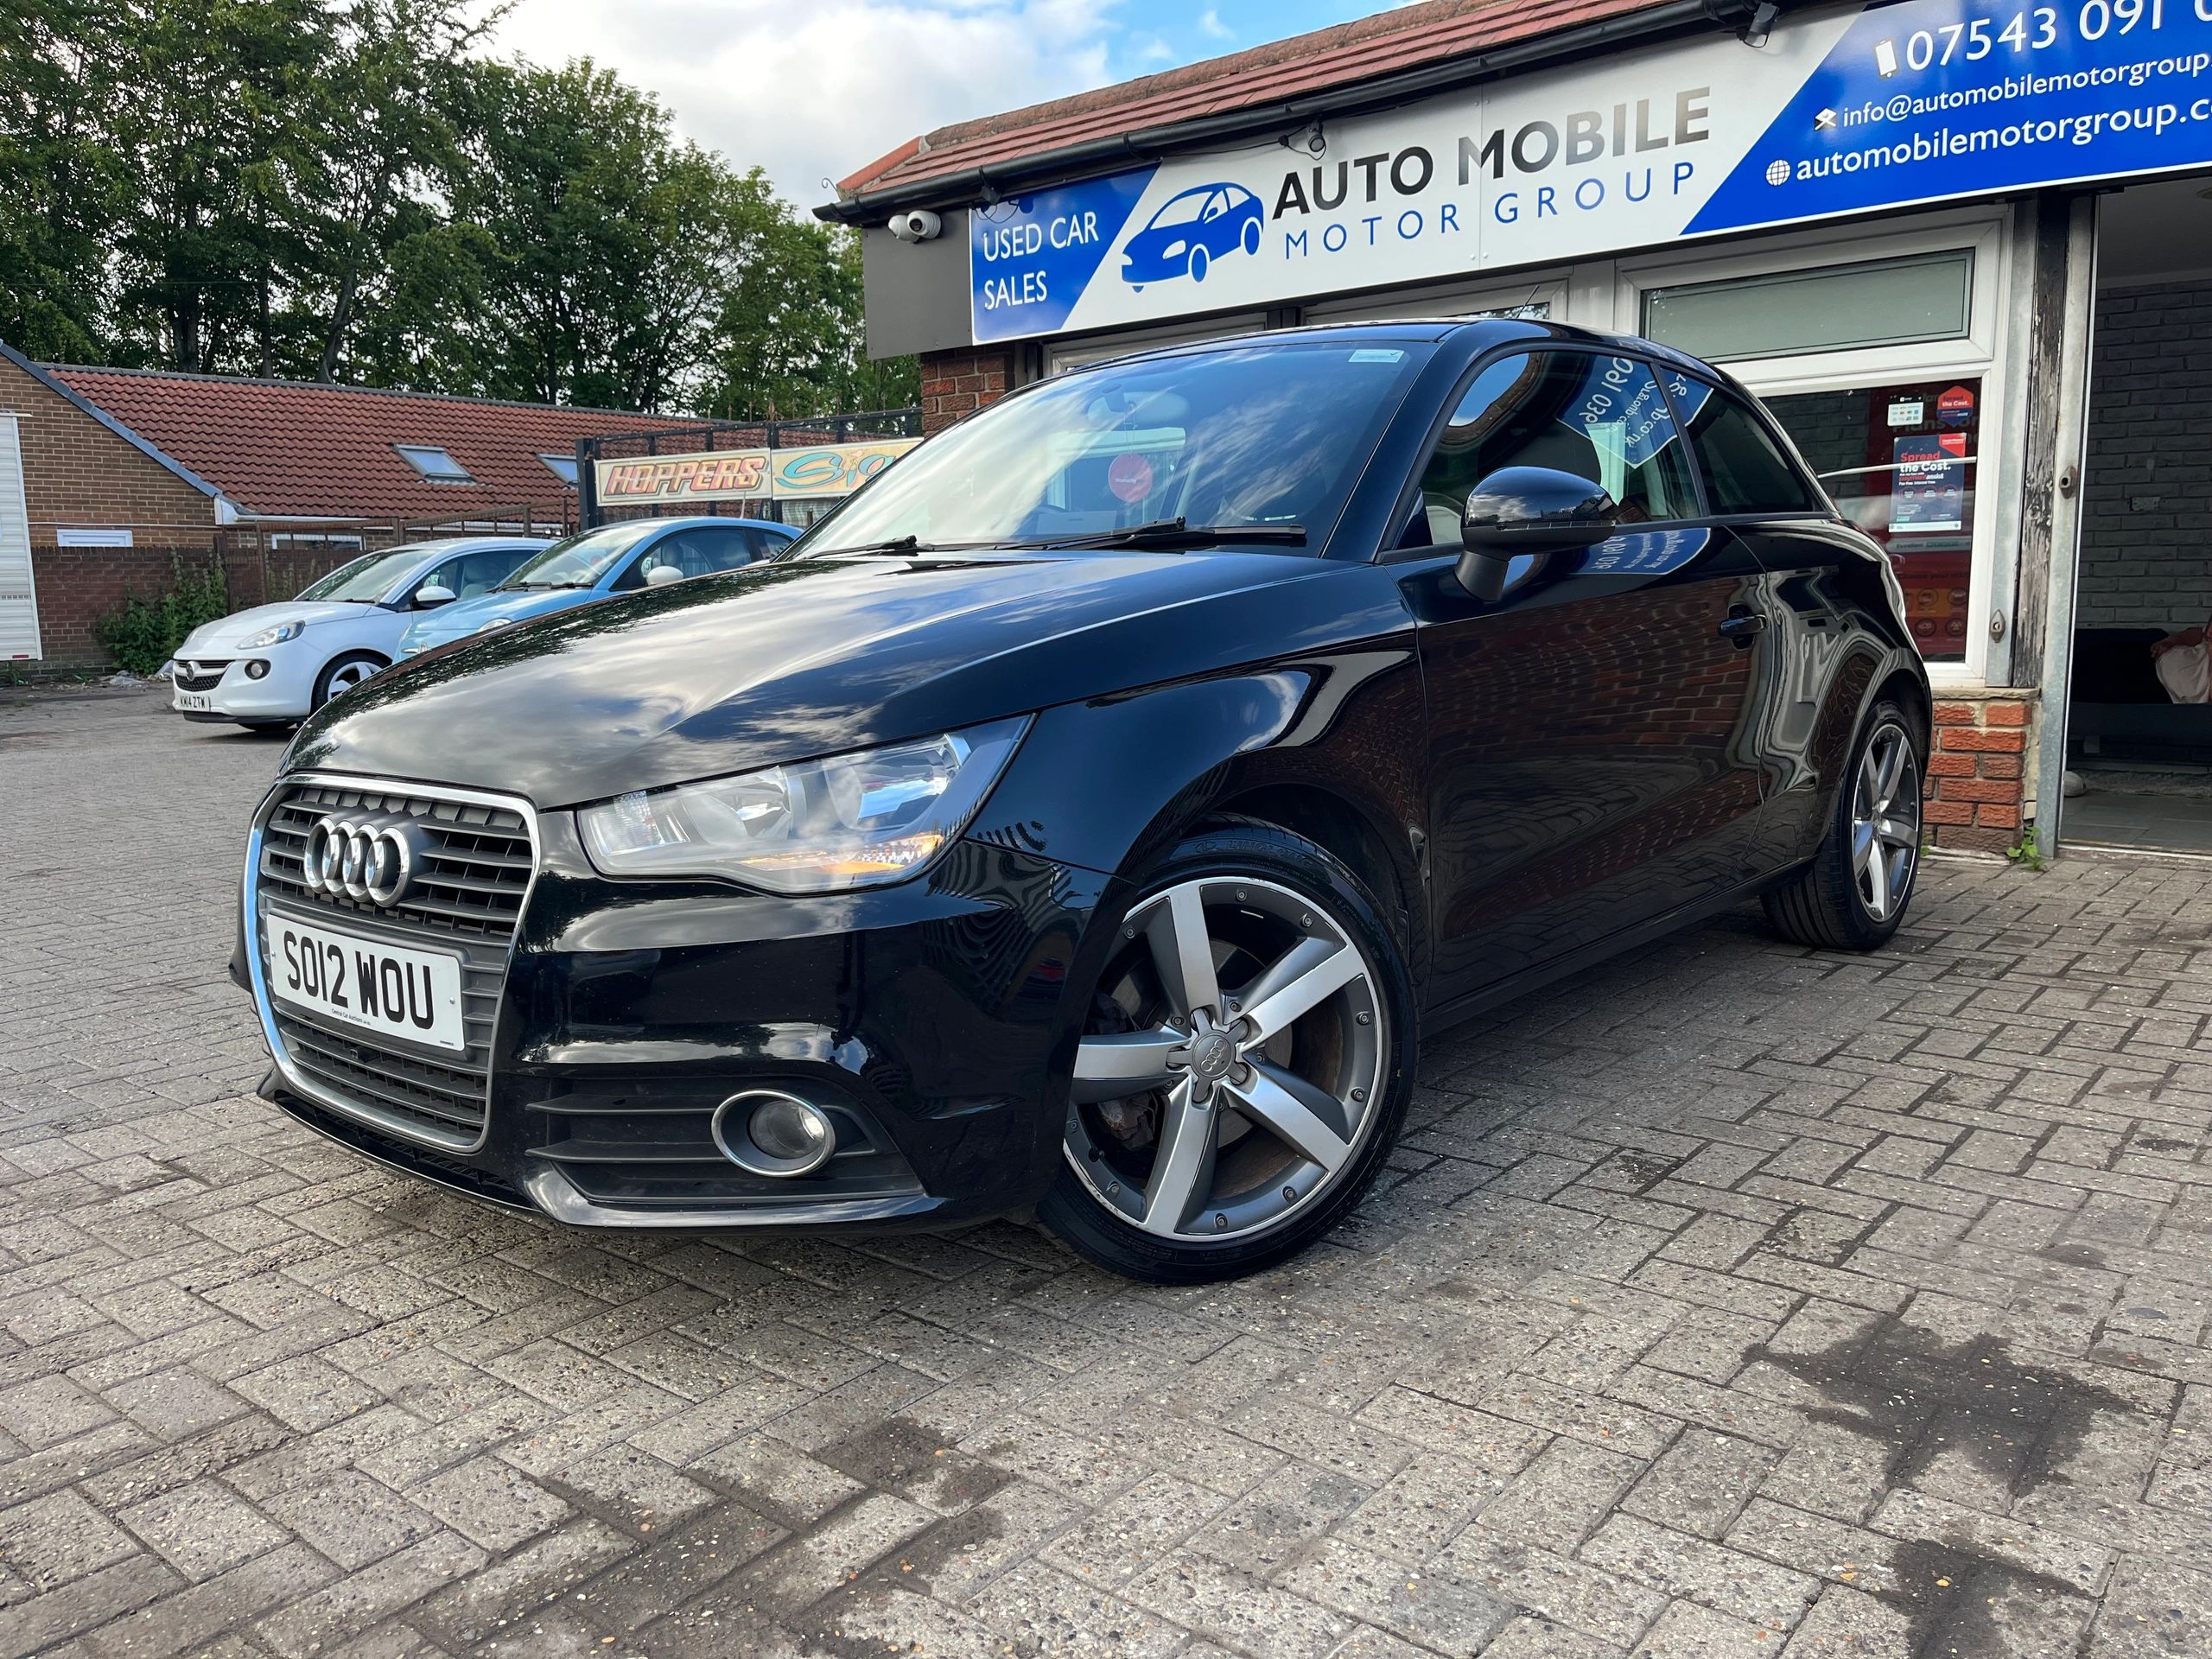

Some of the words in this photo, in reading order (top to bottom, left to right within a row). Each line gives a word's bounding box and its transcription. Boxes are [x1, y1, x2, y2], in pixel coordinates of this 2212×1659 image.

[1906, 7, 2056, 71] 07543
[2079, 0, 2162, 41] 091
[1843, 52, 2212, 128] info@automobilemotorgroup
[1272, 146, 1433, 220] AUTO
[1458, 86, 1710, 186] MOBILE
[1796, 99, 2212, 181] automobilemotorgroup.c
[983, 221, 1041, 262] USED
[1050, 212, 1099, 248] CAR
[1286, 204, 1460, 259] MOTOR
[1494, 161, 1694, 224] GROUP
[983, 271, 1047, 310] SALES
[605, 456, 767, 498] HOPPERS
[1900, 462, 1919, 473] the
[1921, 461, 1952, 473] Cost.
[1901, 450, 1941, 462] Spread
[283, 930, 348, 1009] SO12
[355, 950, 434, 1030] WOU
